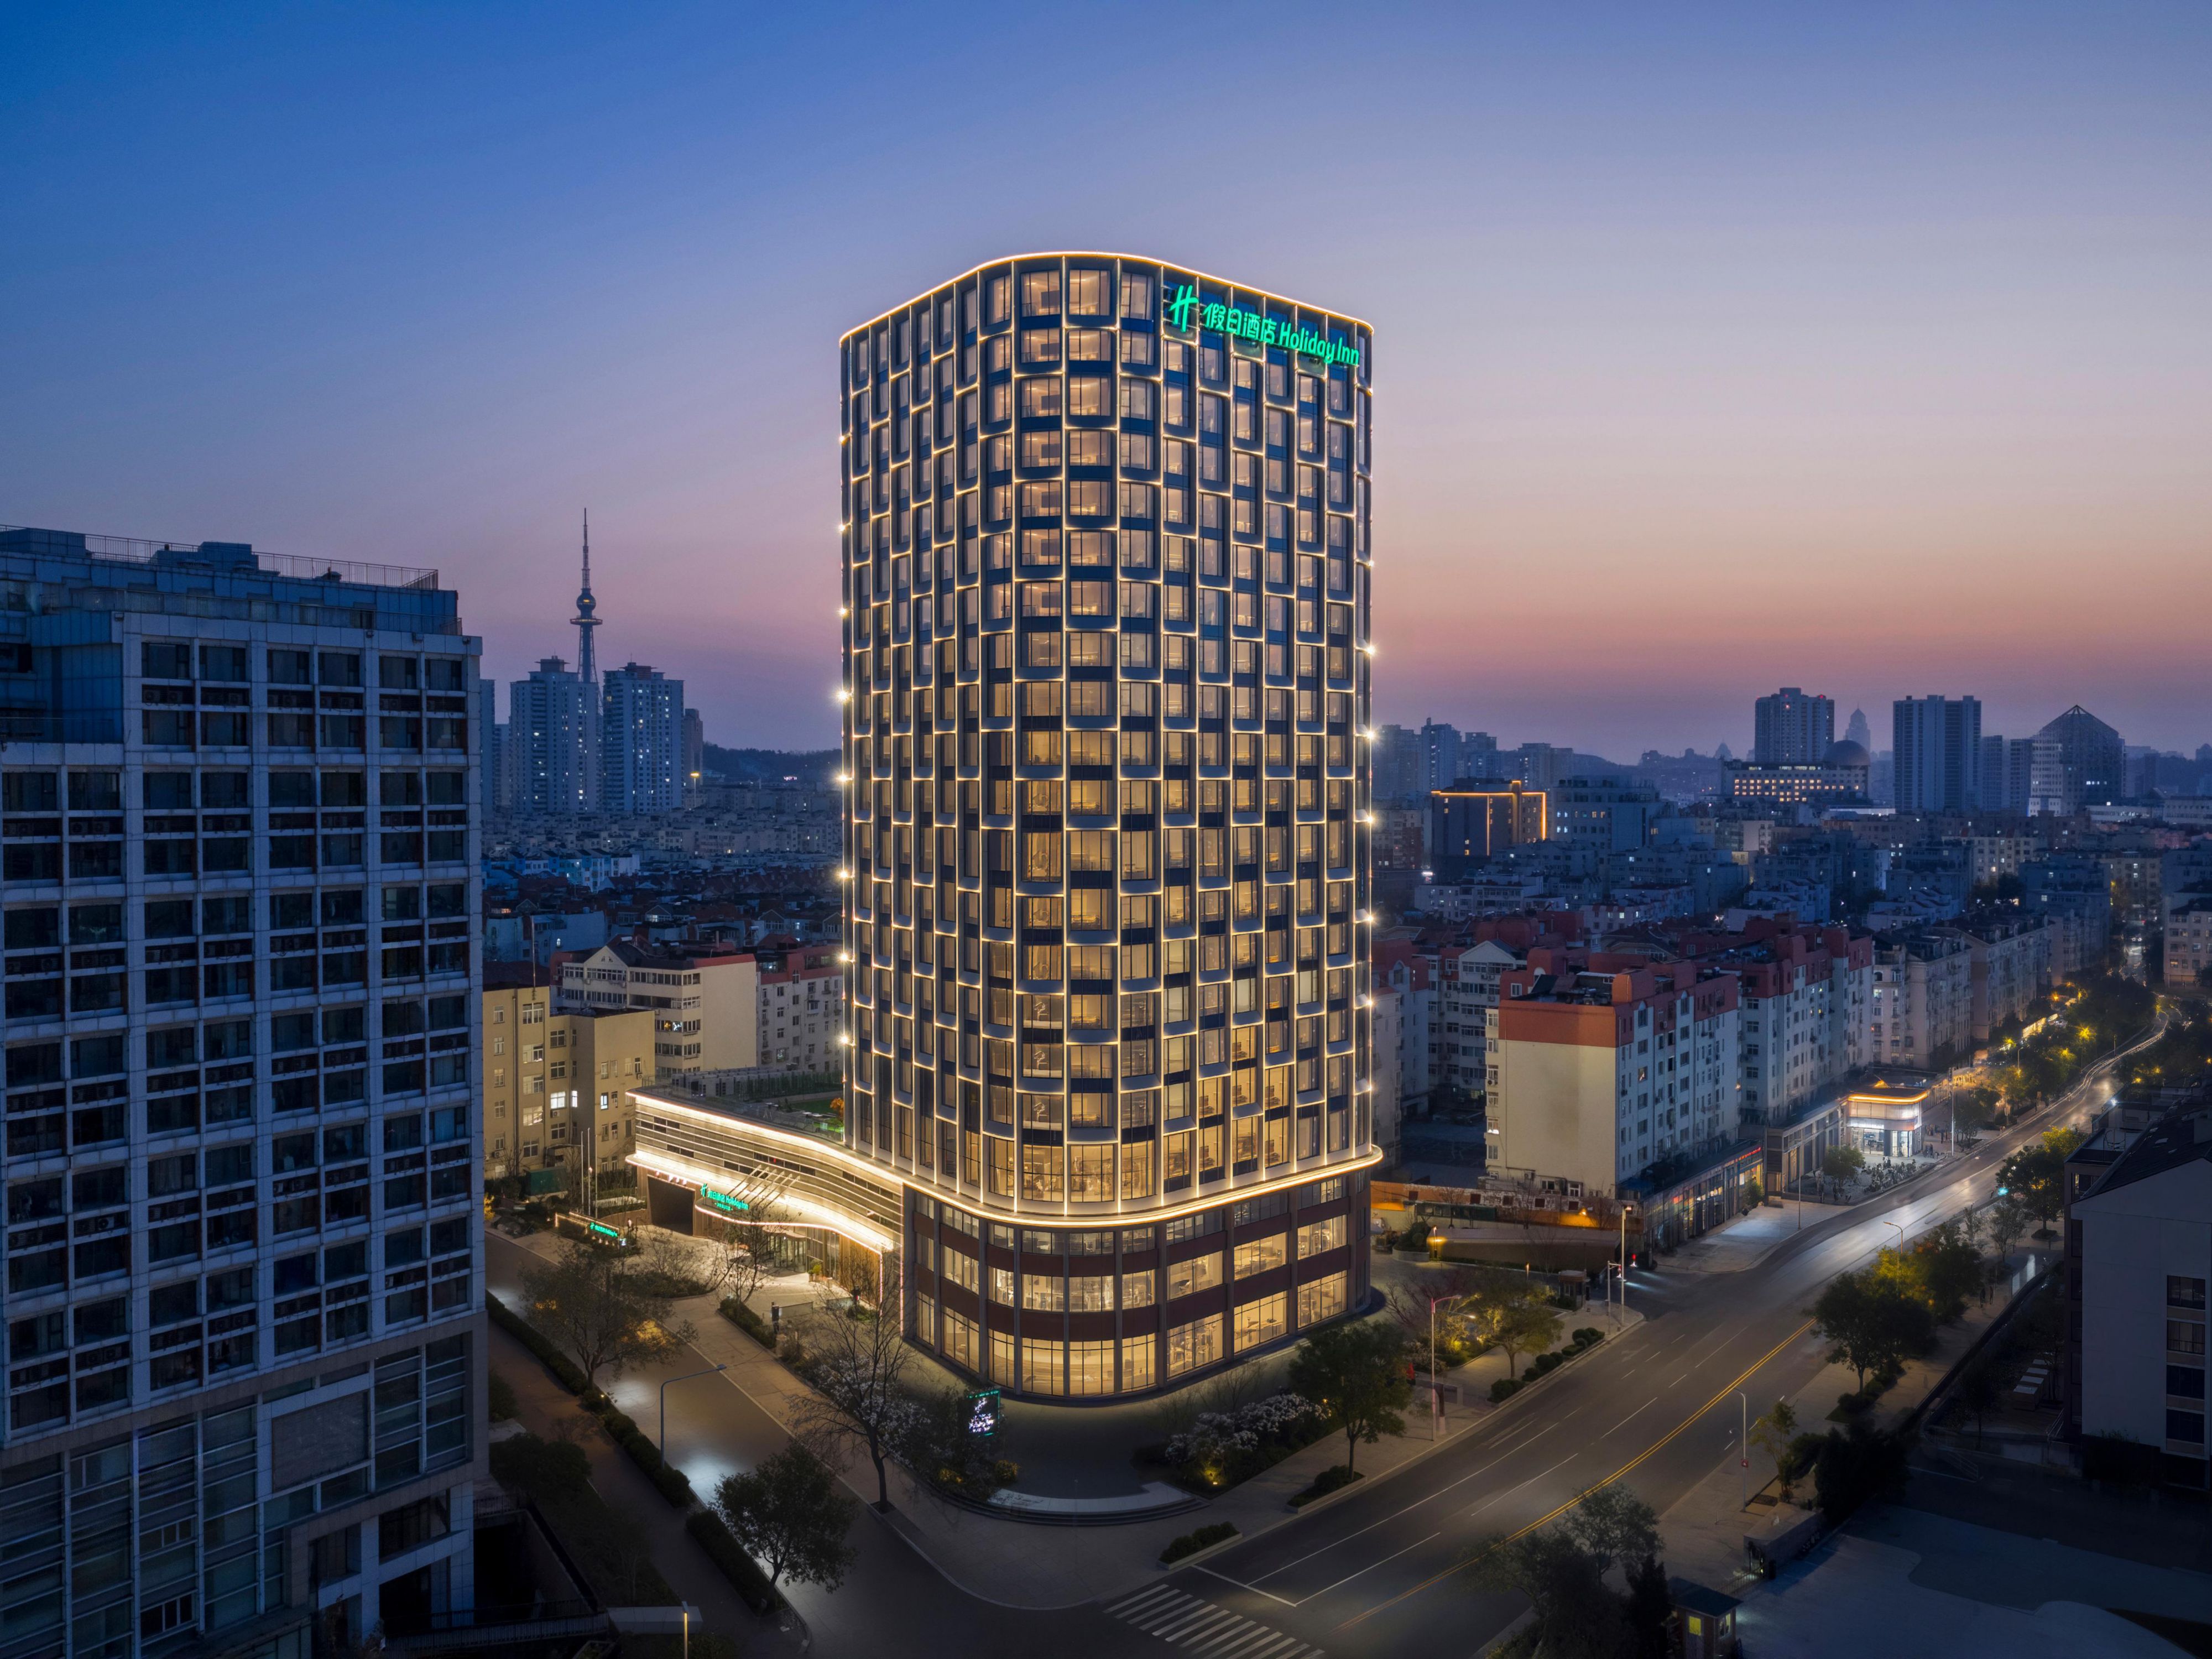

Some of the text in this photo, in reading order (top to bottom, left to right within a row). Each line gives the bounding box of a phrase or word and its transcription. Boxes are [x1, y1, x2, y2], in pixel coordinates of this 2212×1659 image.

[1202, 302, 1359, 366] 假日酒店 Holiday Inn
